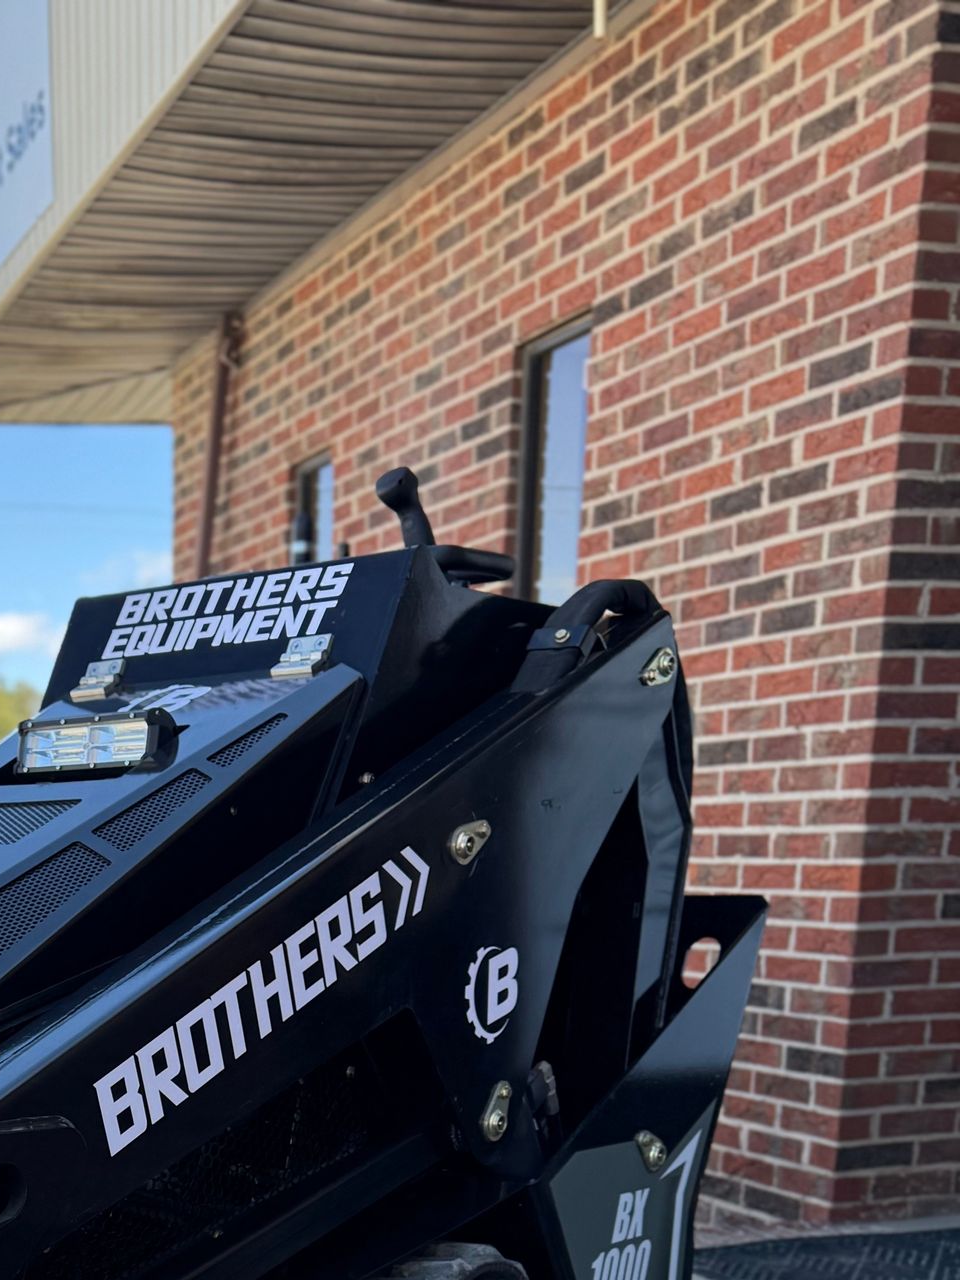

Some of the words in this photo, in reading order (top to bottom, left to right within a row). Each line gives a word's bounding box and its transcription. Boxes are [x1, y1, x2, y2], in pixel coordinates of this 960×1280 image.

[7, 89, 45, 173] Sales
[115, 562, 355, 626] BROTHERS
[101, 600, 338, 660] EQUIPMENT
[93, 871, 387, 1157] BROTHERS
[486, 946, 519, 1025] B
[611, 1187, 650, 1244] BX
